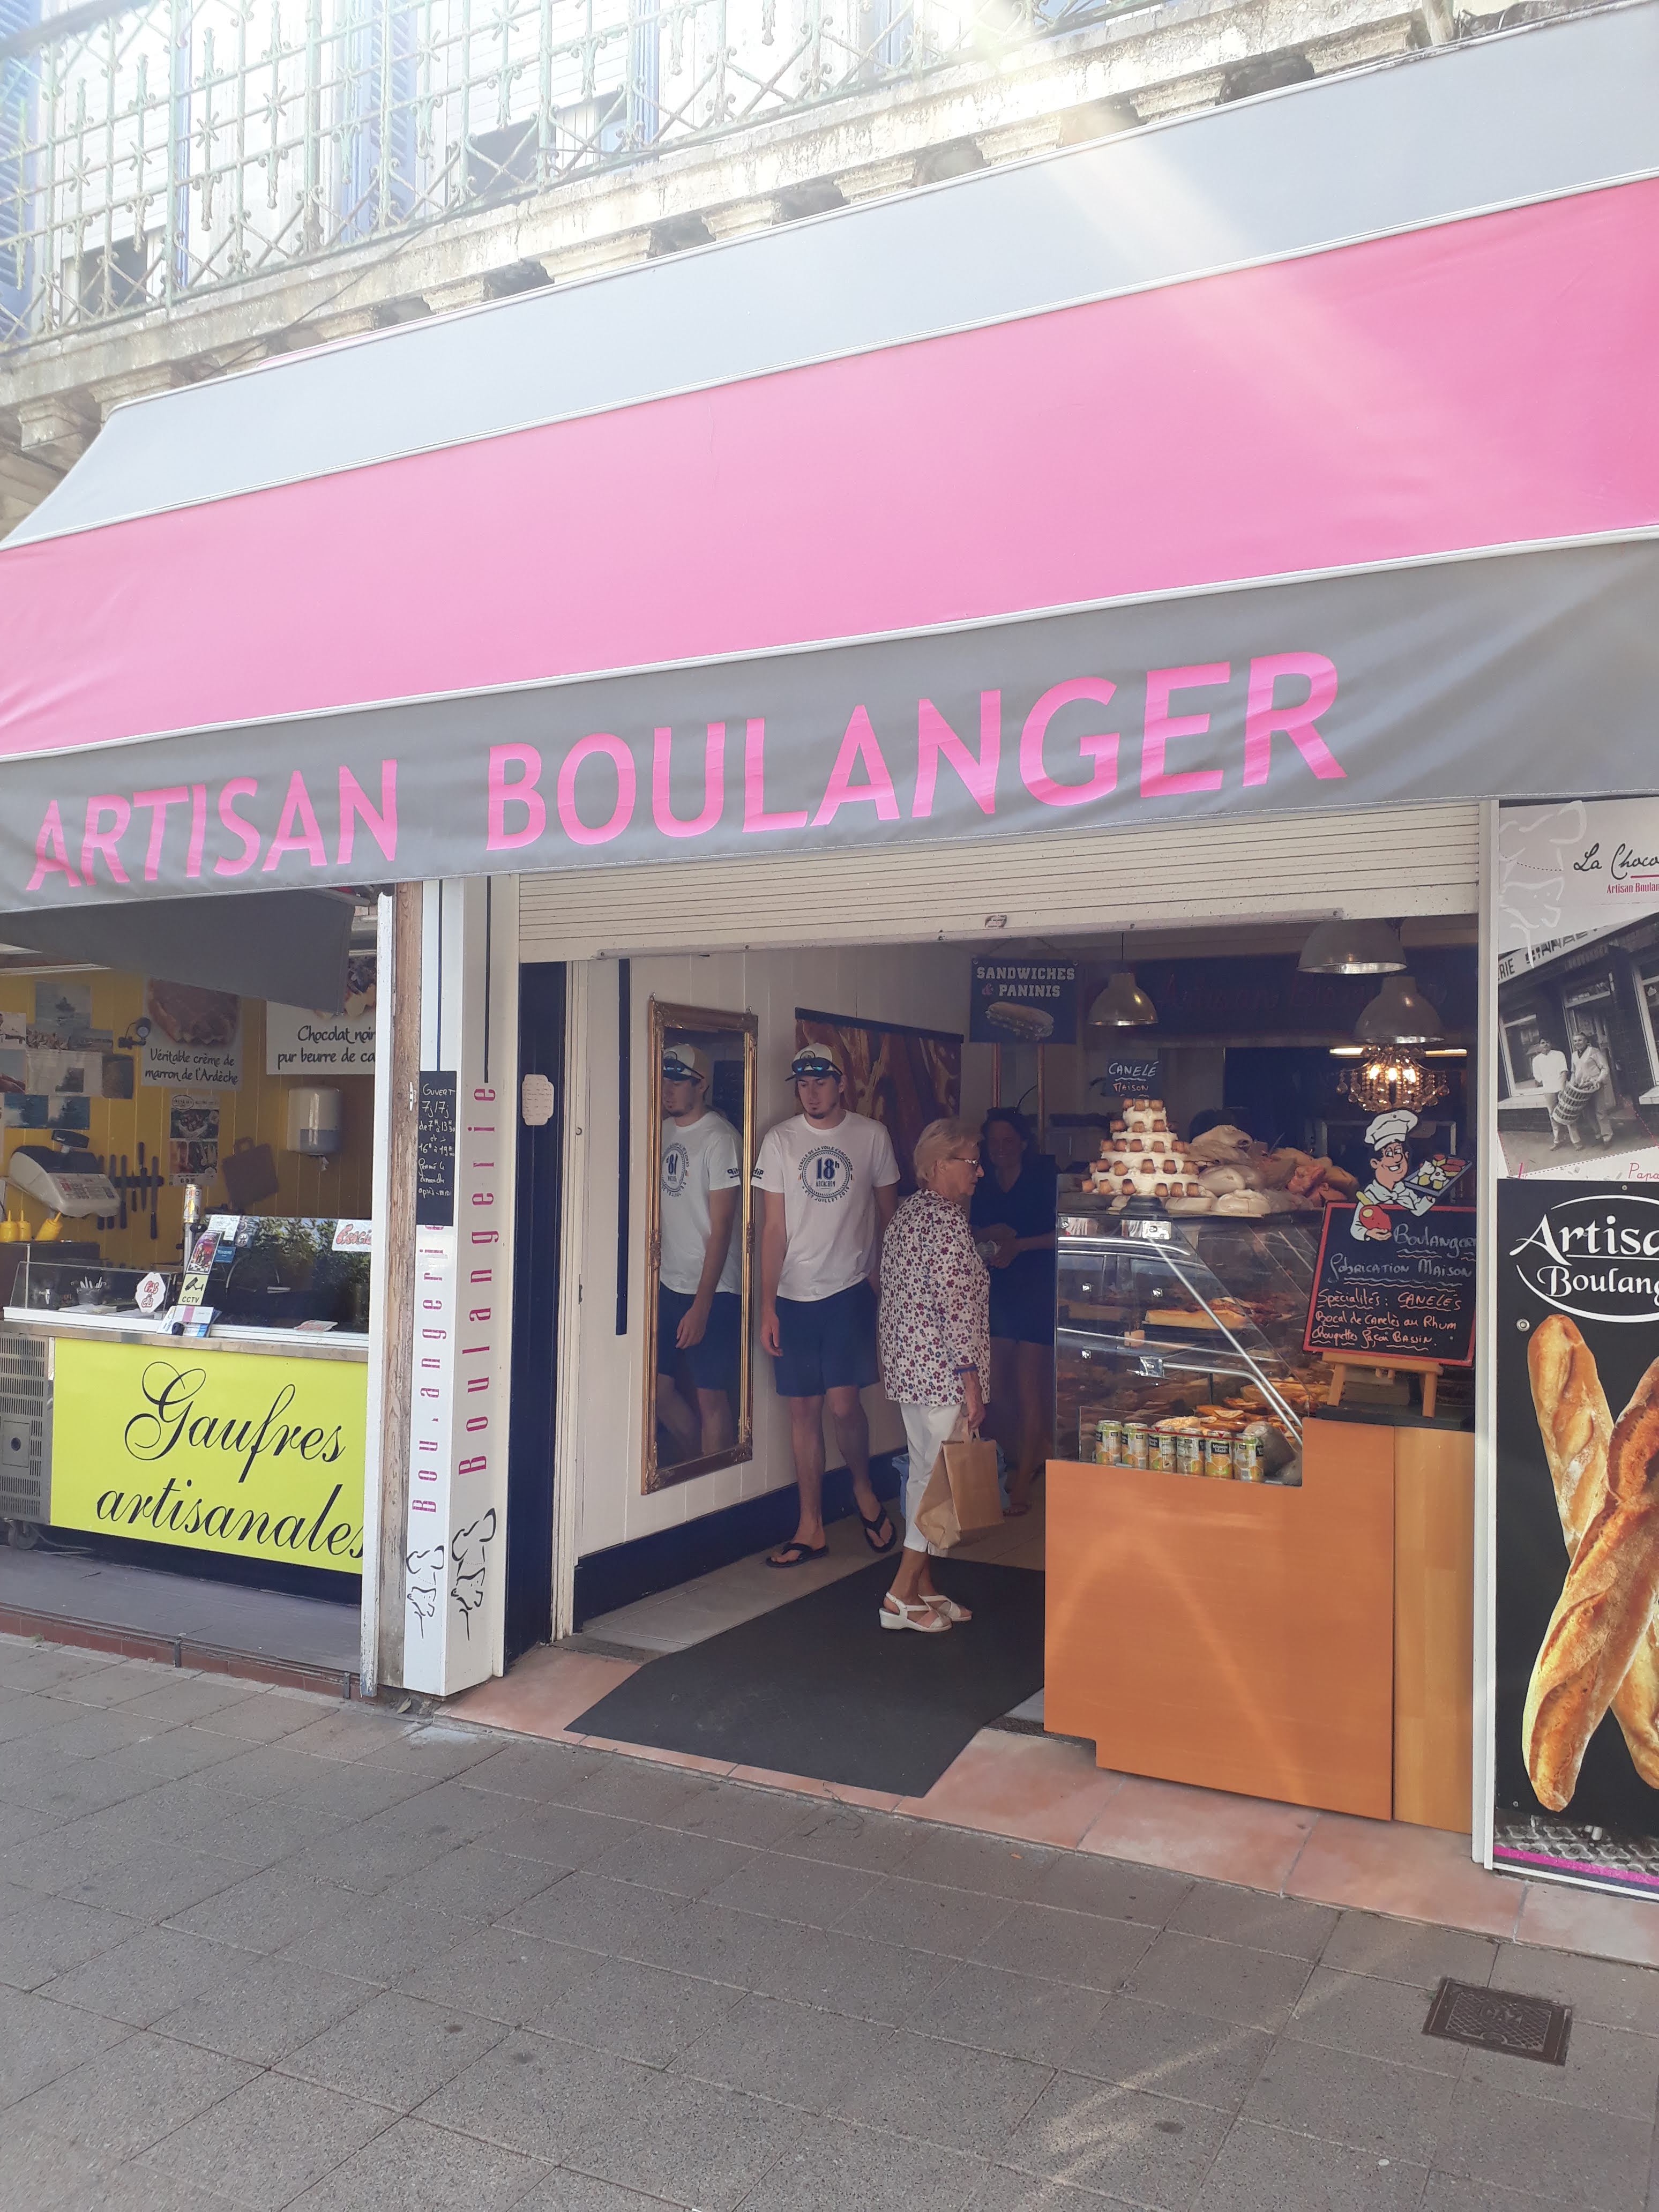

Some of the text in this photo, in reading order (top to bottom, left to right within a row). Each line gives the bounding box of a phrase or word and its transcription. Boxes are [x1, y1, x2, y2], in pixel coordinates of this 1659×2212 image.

[26, 652, 1347, 891] ARTISAN BOULANGER
[1573, 842, 1602, 871] La
[1606, 884, 1633, 894] Artisan
[977, 967, 1075, 980] SANDWICHES
[999, 984, 1060, 997] PANINIS
[298, 1025, 355, 1044] Chocolat
[151, 1048, 234, 1067] Véritable crème de
[278, 1053, 297, 1070] pur
[301, 1048, 337, 1062] beurre
[341, 1047, 355, 1062] de
[145, 1067, 238, 1085] marron de l'Ardèche
[1109, 1061, 1159, 1077] CANELÉ
[798, 1153, 809, 1171] CERCLE
[816, 1157, 840, 1180] 18h
[1509, 1214, 1659, 1266] Artisa
[459, 1088, 499, 1476] Boulangerie
[1350, 1312, 1362, 1325] de
[1423, 1315, 1456, 1329] Rhum
[412, 1224, 447, 1513] Bouangeri
[125, 1362, 346, 1483] Gaufres
[96, 1478, 363, 1558] artisanales
